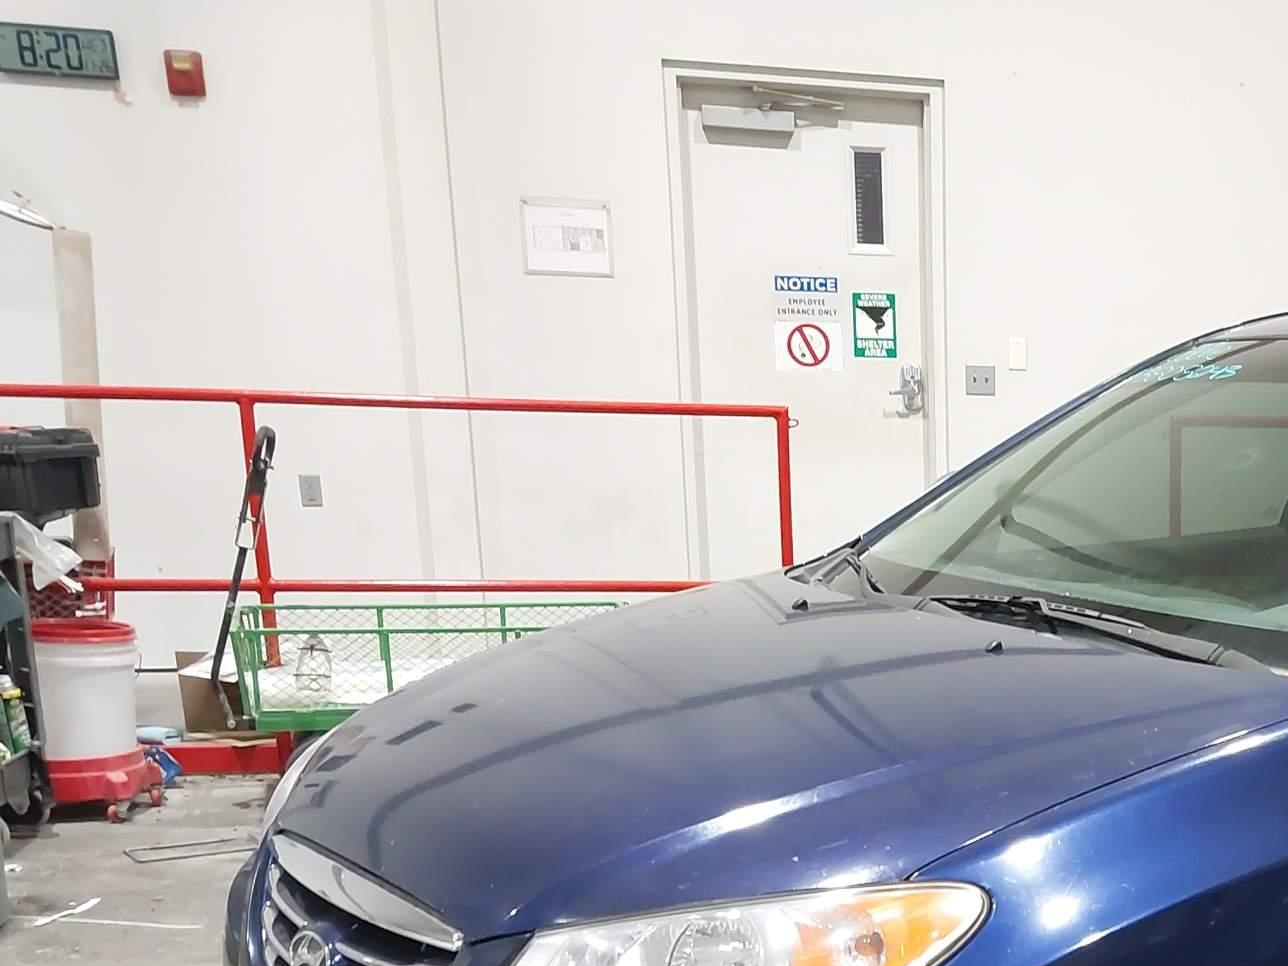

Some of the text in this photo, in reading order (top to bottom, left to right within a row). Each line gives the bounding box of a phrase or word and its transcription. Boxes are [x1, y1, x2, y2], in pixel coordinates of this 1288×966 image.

[16, 30, 84, 70] 8:20
[776, 277, 836, 292] NOTICE
[788, 297, 826, 306] EMPLOYEE
[777, 307, 838, 317] ENTRANCE ONLY
[857, 339, 895, 349] SHELTER
[864, 348, 888, 357] AREA
